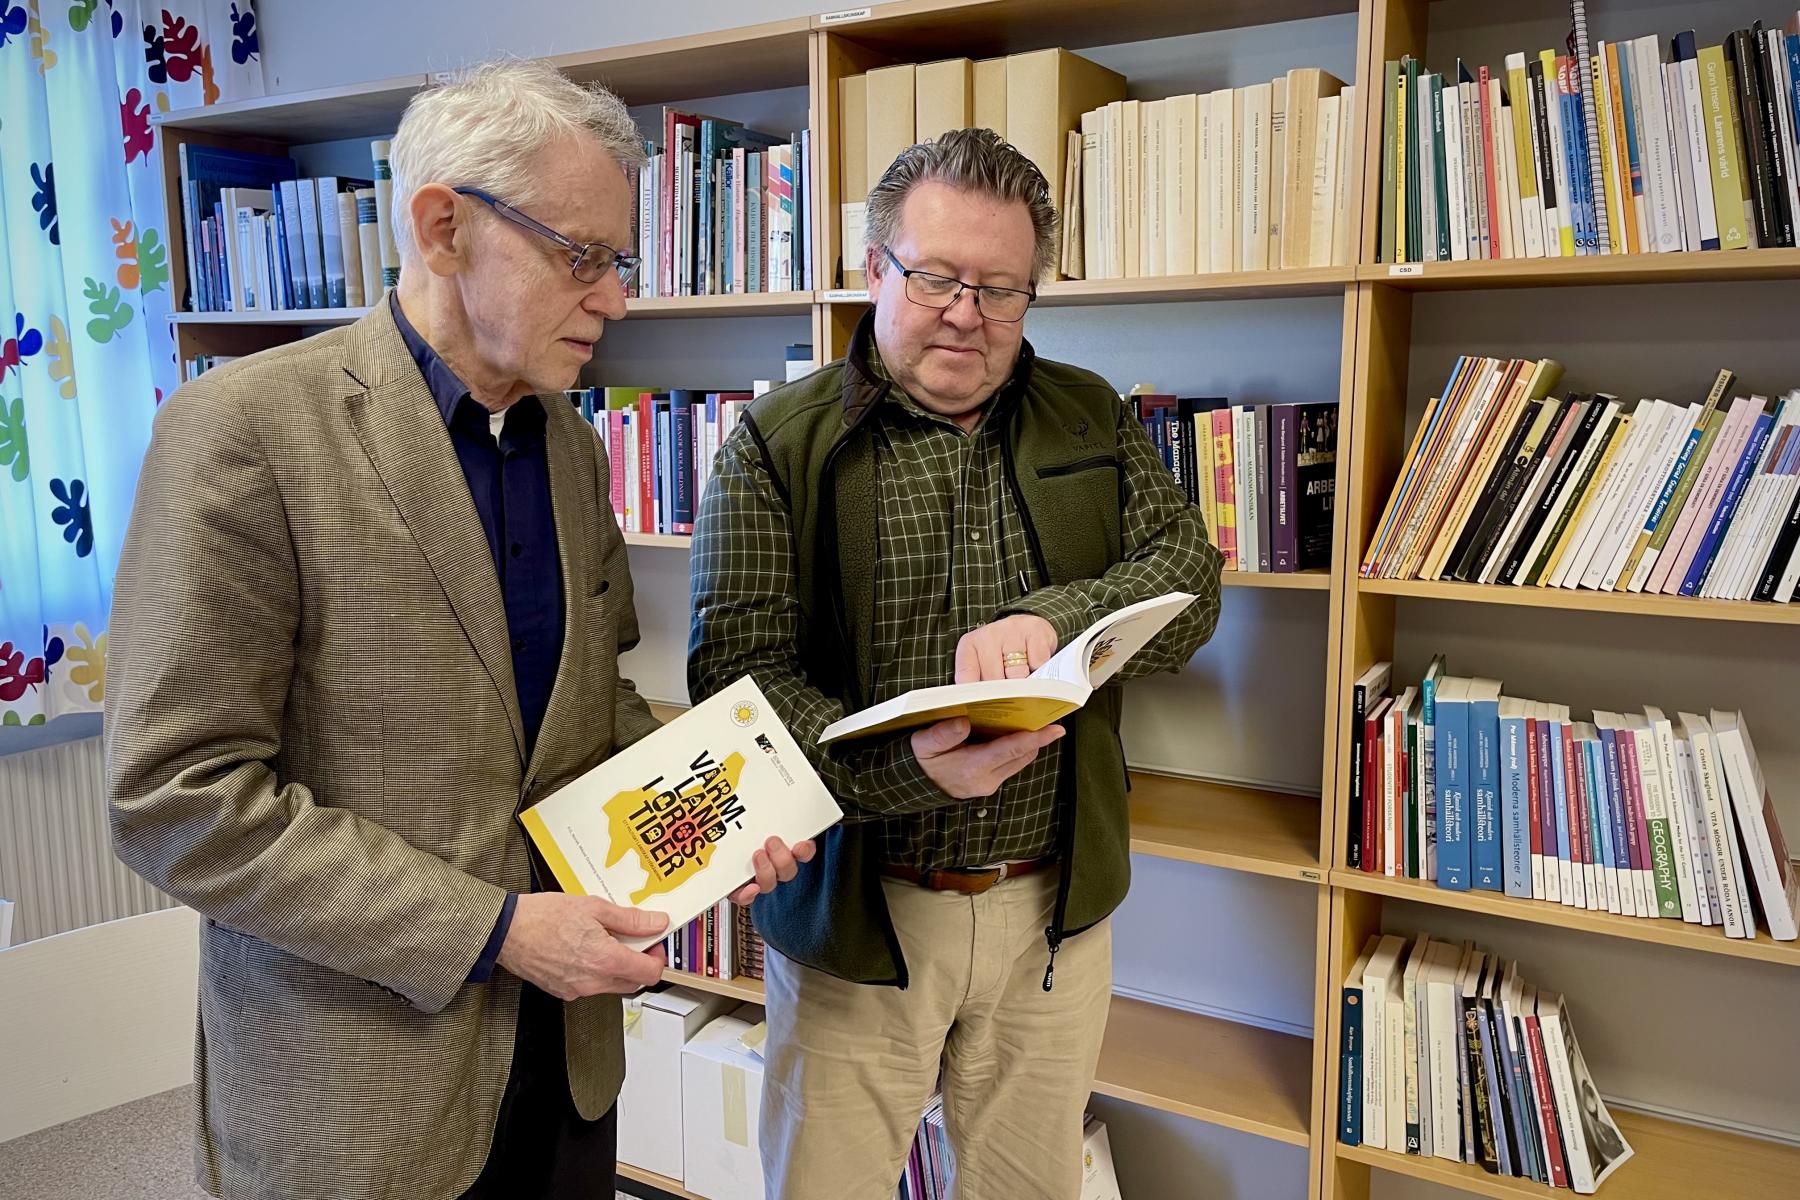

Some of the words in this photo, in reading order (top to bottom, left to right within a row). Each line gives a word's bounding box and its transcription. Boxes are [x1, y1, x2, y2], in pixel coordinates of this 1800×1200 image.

[1706, 62, 1718, 85] Gunn
[1710, 87, 1721, 112] Imsen
[1713, 115, 1725, 155] Lärarens
[1718, 155, 1730, 178] värld
[644, 188, 652, 239] HISTORIA
[1711, 373, 1728, 398] FISHER
[1171, 421, 1180, 438] The
[1680, 436, 1698, 462] Amazing
[1172, 440, 1182, 485] Managed
[1671, 460, 1686, 479] Social
[1306, 479, 1335, 496] ARBE
[1497, 488, 1508, 501] del
[1662, 477, 1678, 499] Studies
[1322, 496, 1335, 511] LI
[1699, 747, 1708, 770] Crister
[642, 776, 664, 792] I
[690, 750, 746, 830] VÄRM-
[1512, 771, 1522, 809] Moderna
[1609, 772, 1618, 791] politisk
[1701, 771, 1714, 801] Skoglund
[673, 776, 727, 843] LAND
[1445, 789, 1455, 842] samhällsteori
[1477, 789, 1487, 841] samhällsteori
[1612, 791, 1622, 824] organisation
[629, 800, 685, 877] TIDER
[652, 791, 706, 866] OROS-
[1512, 810, 1523, 874] samhällsteorier
[1713, 829, 1723, 857] MÖSSOR
[1652, 820, 1672, 890] GEOGRAPHY
[1718, 858, 1728, 881] UNDER
[1722, 883, 1731, 902] RÖDA
[1726, 904, 1736, 927] FANOR
